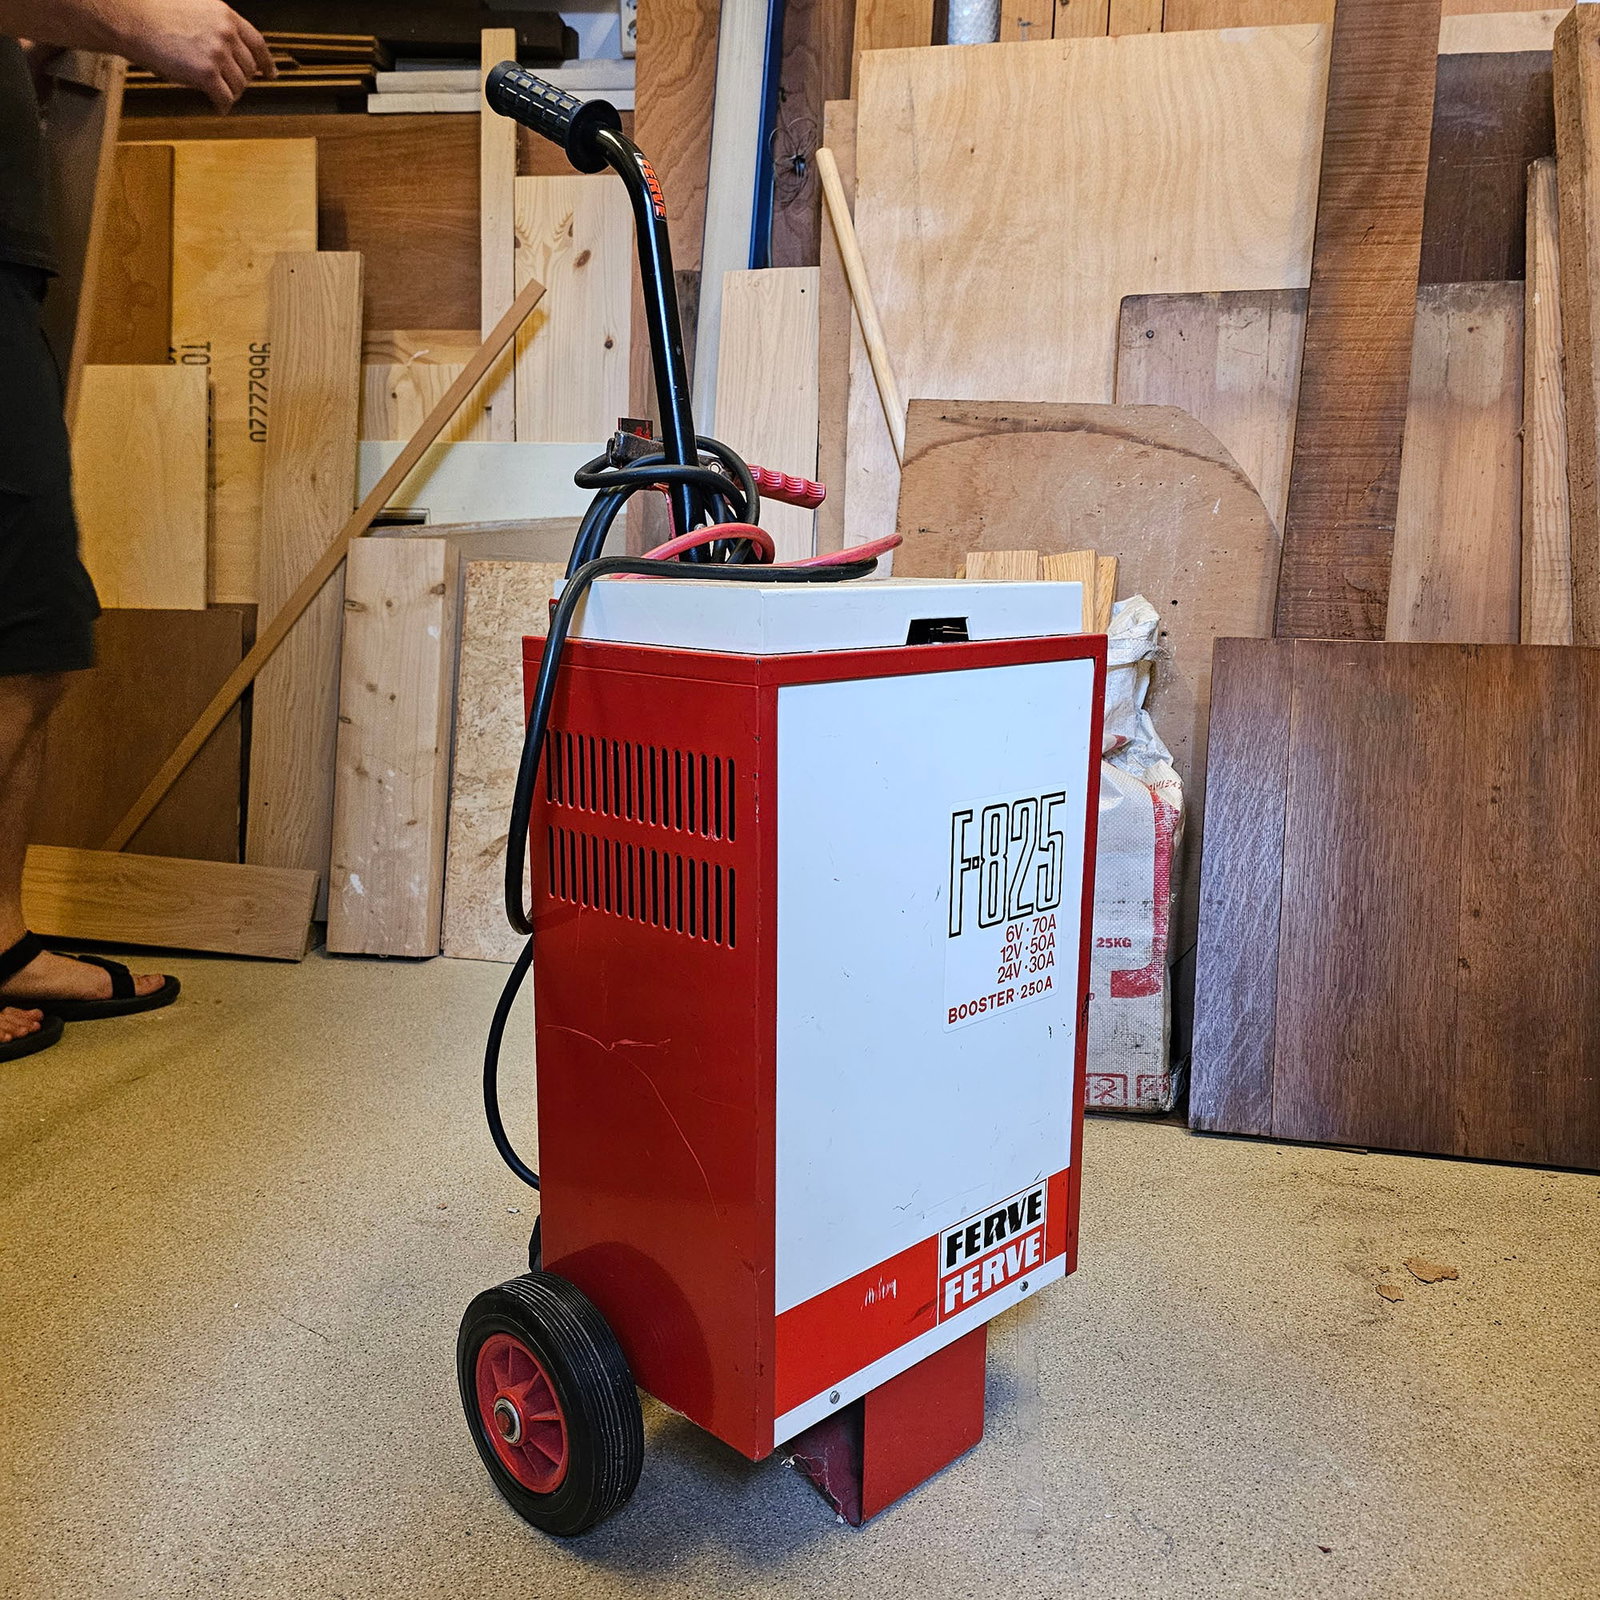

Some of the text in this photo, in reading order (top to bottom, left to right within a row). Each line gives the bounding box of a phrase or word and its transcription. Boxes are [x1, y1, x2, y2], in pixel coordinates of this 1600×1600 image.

[641, 160, 667, 217] FERVE
[1096, 937, 1132, 948] 25KG
[946, 1189, 1042, 1269] FERVE
[944, 1231, 1041, 1315] FERVE
